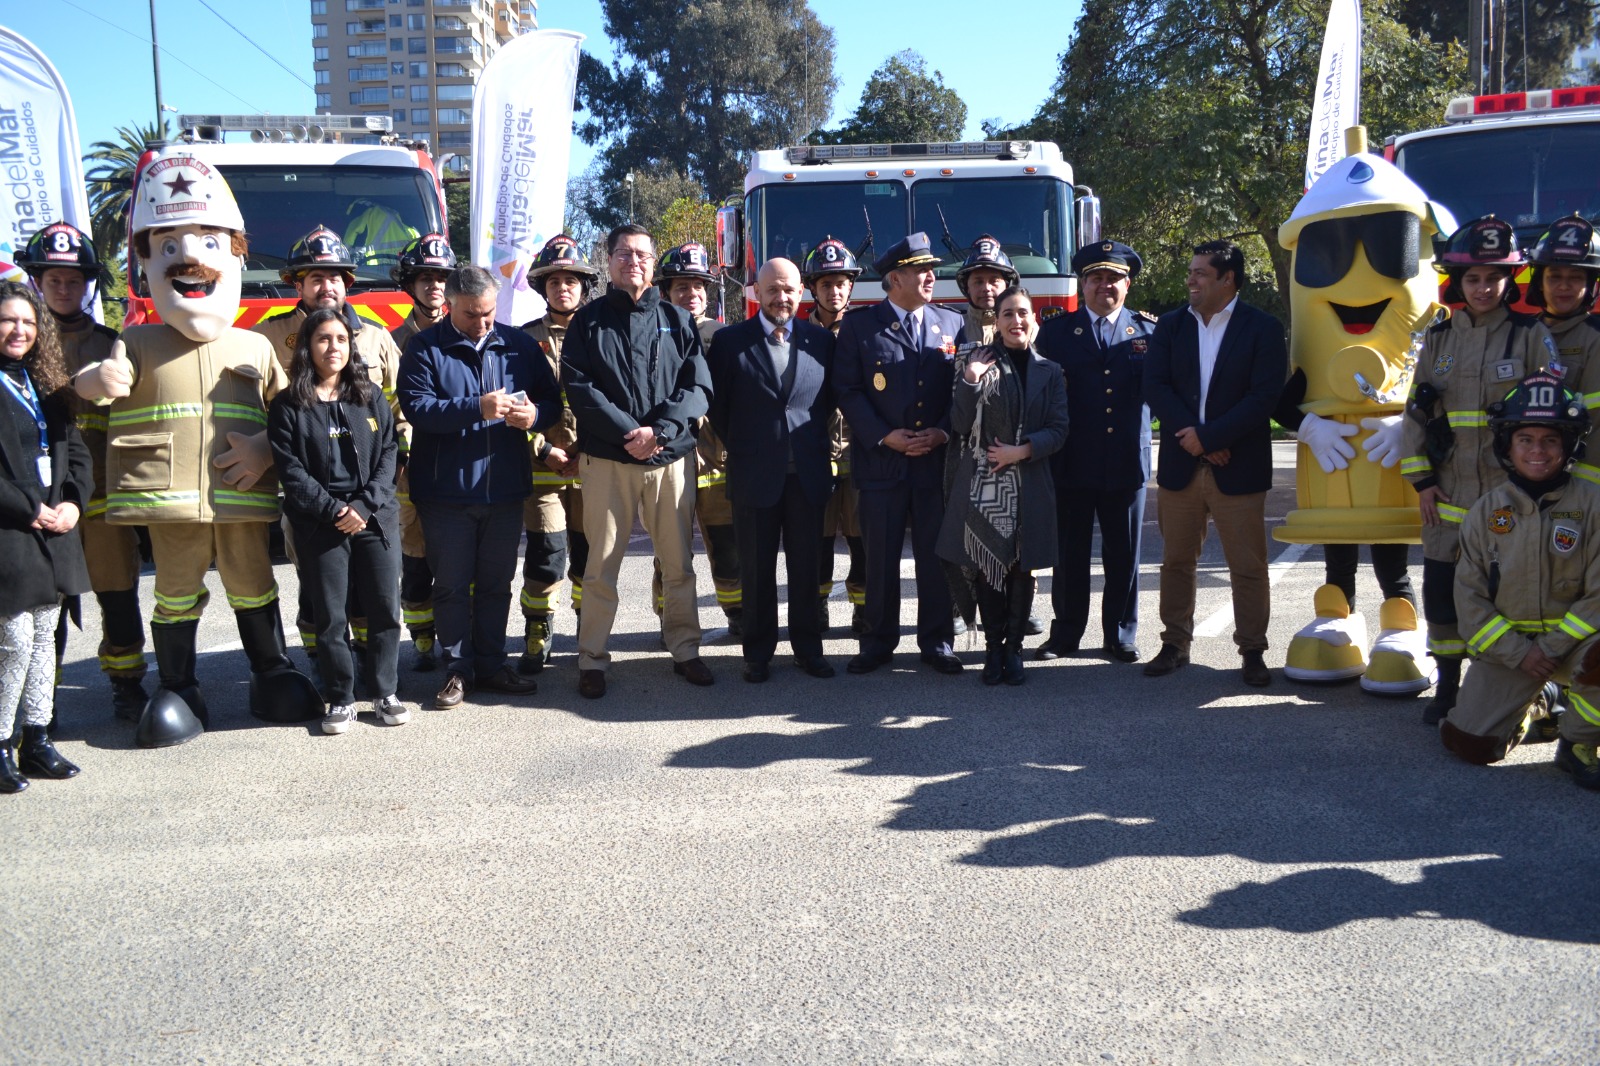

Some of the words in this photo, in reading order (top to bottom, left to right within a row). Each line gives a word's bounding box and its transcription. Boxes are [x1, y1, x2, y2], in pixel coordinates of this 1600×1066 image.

[1331, 102, 1341, 118] de
[21, 101, 41, 167] Cuidados
[1330, 121, 1341, 167] unicipio
[171, 158, 187, 166] DEL
[188, 159, 207, 173] MAR
[32, 169, 45, 187] de
[36, 190, 54, 228] icipio
[157, 202, 206, 214] COMANDANTE
[54, 232, 70, 252] 8
[1482, 229, 1499, 249] 3
[1558, 227, 1578, 246] 4
[429, 240, 444, 256] 6
[555, 244, 569, 258] 7
[826, 246, 837, 262] 8
[980, 242, 991, 254] 2
[1528, 386, 1554, 407] 10
